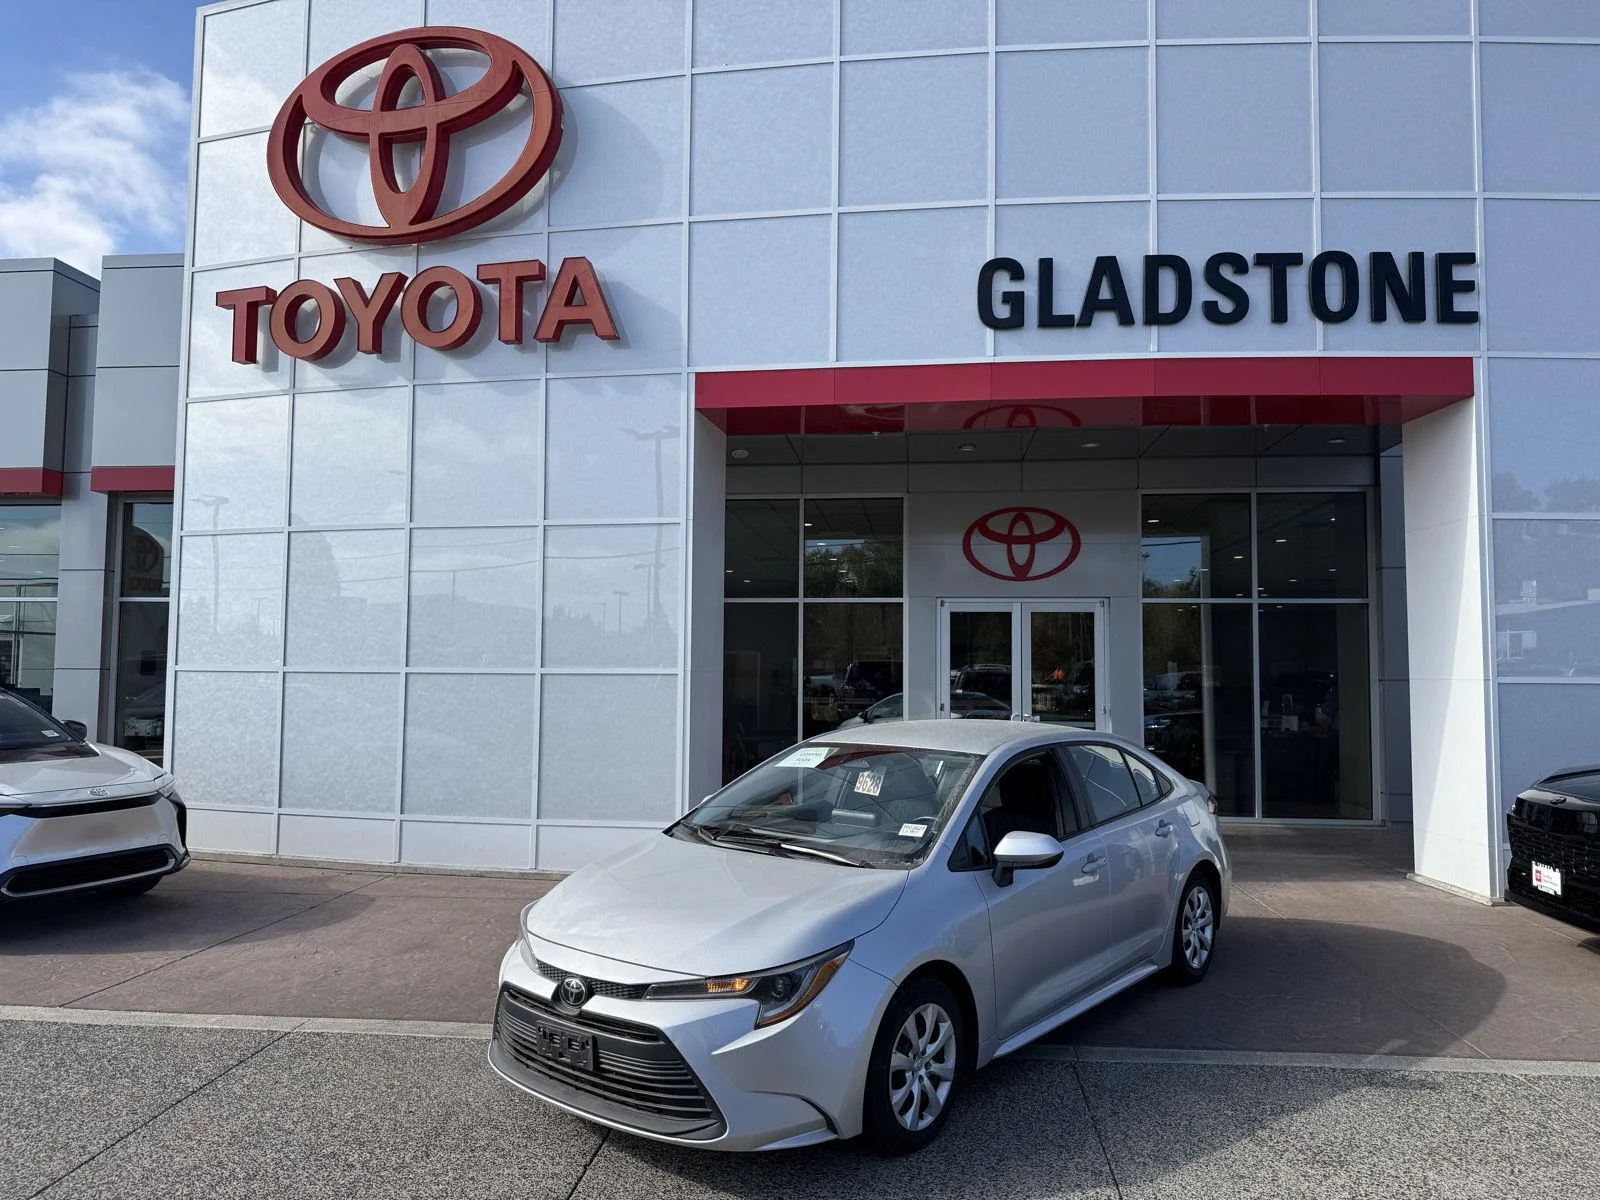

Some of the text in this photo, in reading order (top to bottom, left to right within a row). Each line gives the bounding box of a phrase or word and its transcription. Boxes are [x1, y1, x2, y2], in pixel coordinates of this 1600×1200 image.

[216, 256, 620, 365] TOYOTA
[977, 250, 1479, 329] GLADSTONE
[856, 773, 882, 795] 9628
